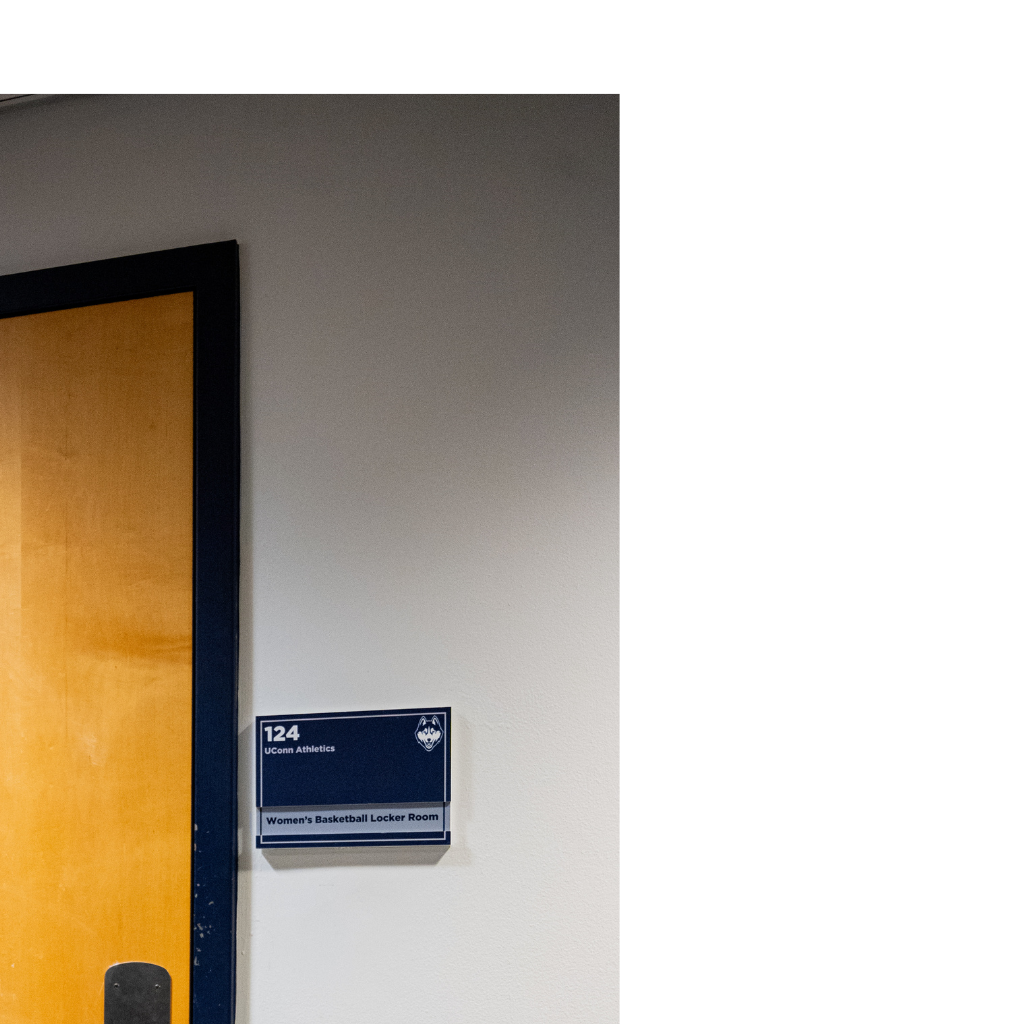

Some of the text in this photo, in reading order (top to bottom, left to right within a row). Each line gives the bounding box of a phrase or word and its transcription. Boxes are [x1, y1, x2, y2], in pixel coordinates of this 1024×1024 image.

[264, 724, 300, 742] 124
[264, 744, 336, 755] UConn Athletics
[266, 813, 439, 825] Women's Basketball Locker Room
